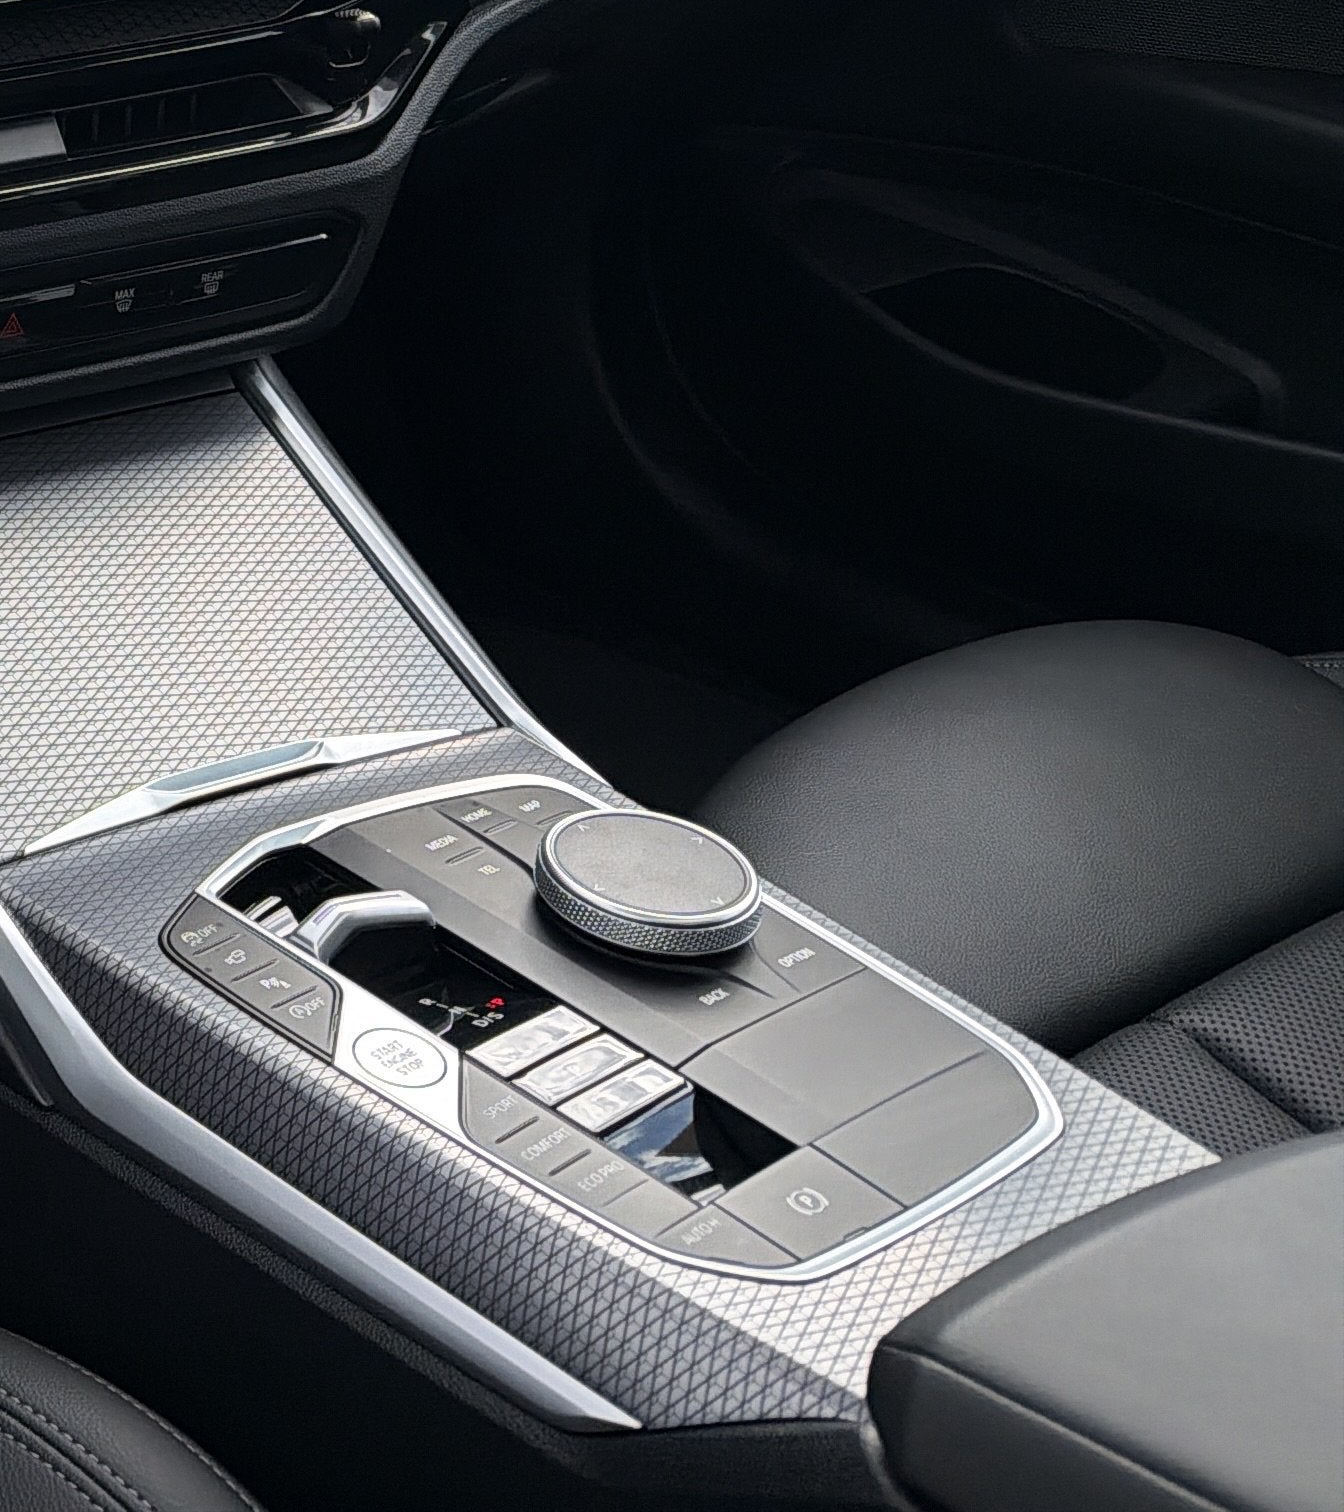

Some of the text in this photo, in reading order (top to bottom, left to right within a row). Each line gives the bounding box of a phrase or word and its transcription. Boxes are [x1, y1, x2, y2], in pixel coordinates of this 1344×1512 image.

[201, 270, 224, 283] REAR
[115, 288, 136, 300] MAX
[198, 923, 218, 938] OFF
[777, 947, 816, 968] OPTION
[306, 996, 326, 1012] OFF
[698, 987, 730, 1006] BACK
[483, 1094, 520, 1120] SPORT
[520, 1128, 572, 1162] COMFORT
[577, 1160, 626, 1193] ECO PRO
